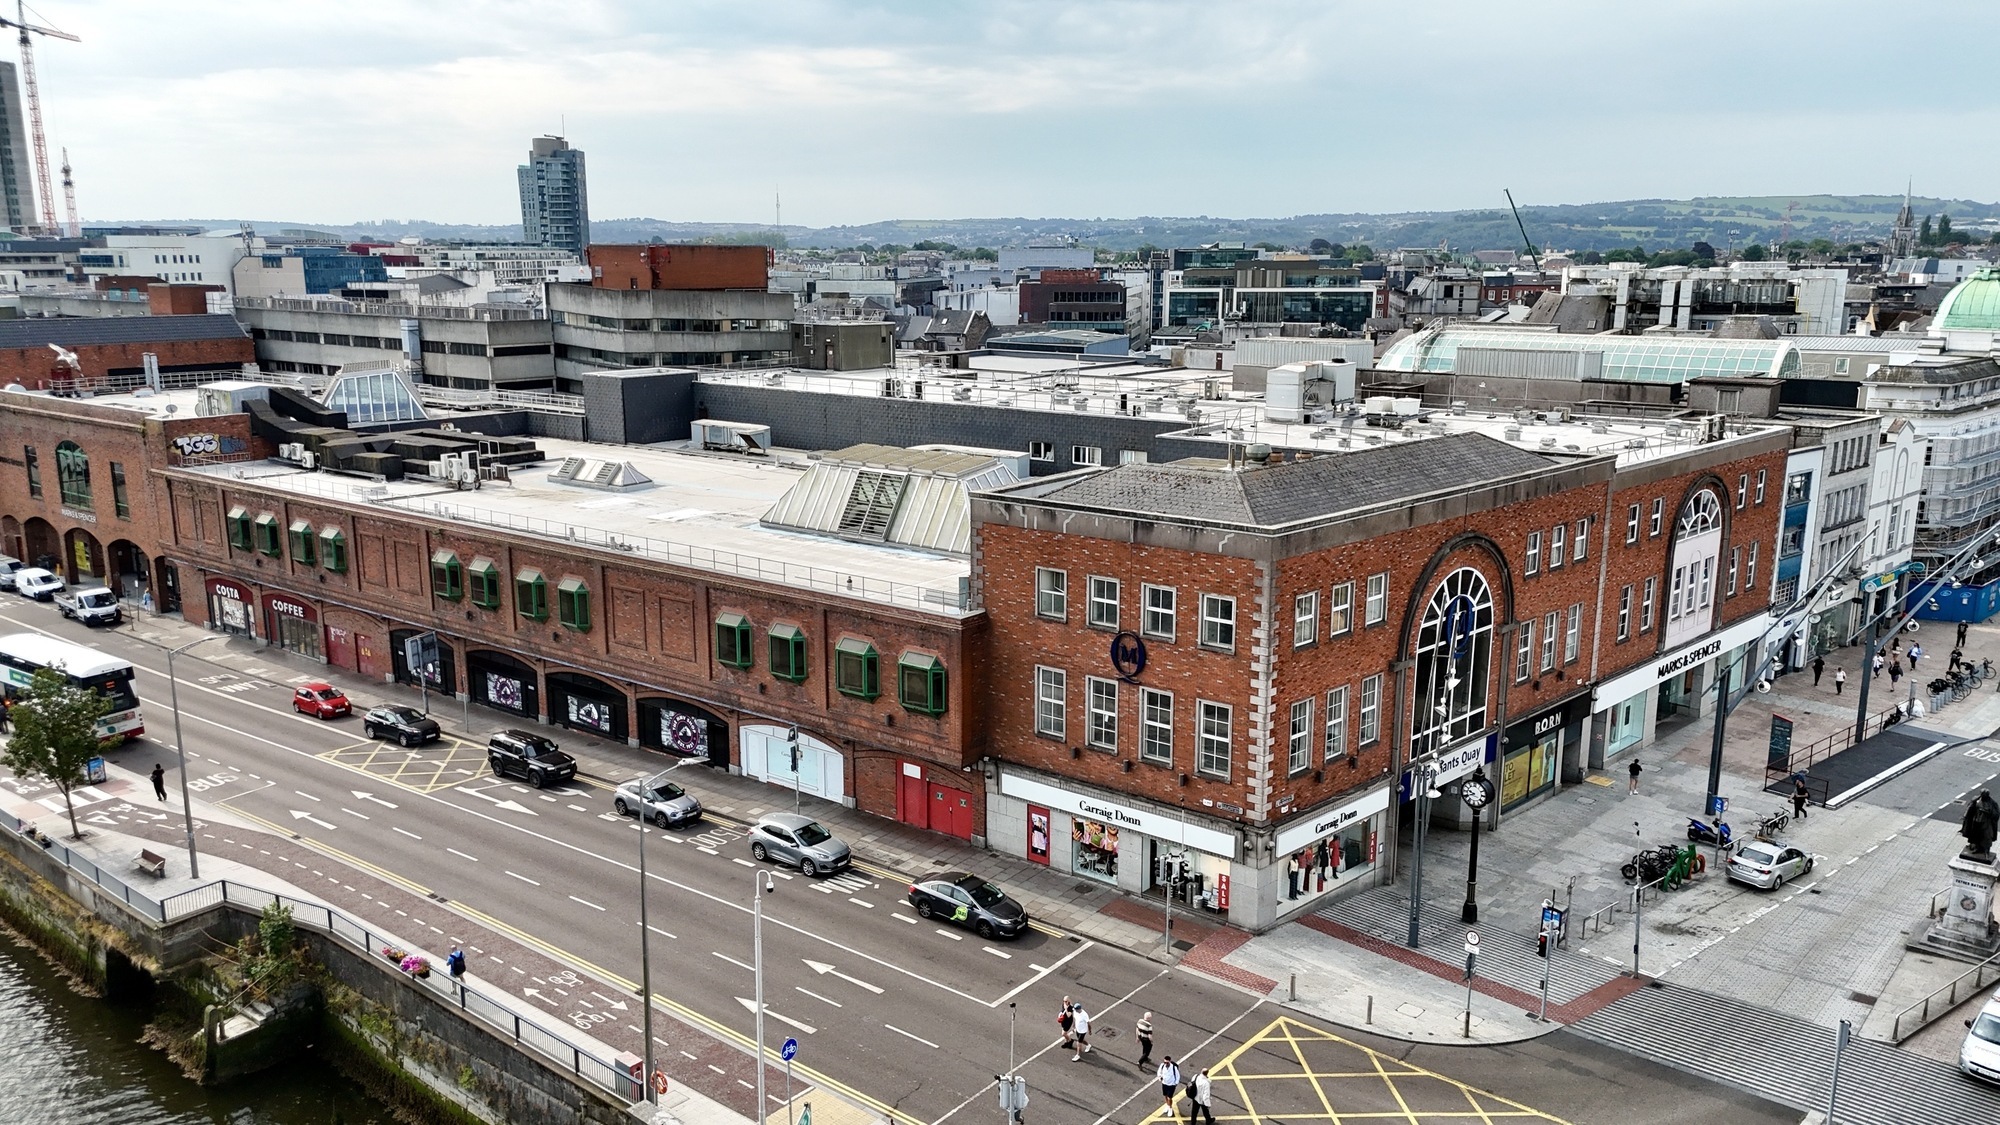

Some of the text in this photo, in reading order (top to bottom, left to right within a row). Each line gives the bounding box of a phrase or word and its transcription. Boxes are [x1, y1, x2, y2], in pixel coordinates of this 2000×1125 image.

[175, 433, 218, 456] TGS
[79, 512, 97, 523] SPENCER
[216, 584, 240, 599] COSTA
[272, 600, 304, 617] COFFEE
[1658, 640, 1721, 679] MARKS & SPENCER
[1534, 712, 1562, 735] BORN
[1462, 746, 1481, 766] Quay
[1963, 748, 2000, 763] BUS
[1504, 770, 1516, 781] LET
[1505, 762, 1514, 772] TO
[186, 772, 239, 792] BUS
[1080, 800, 1141, 826] Carraig Donn
[1315, 810, 1358, 834] Carraig Donn
